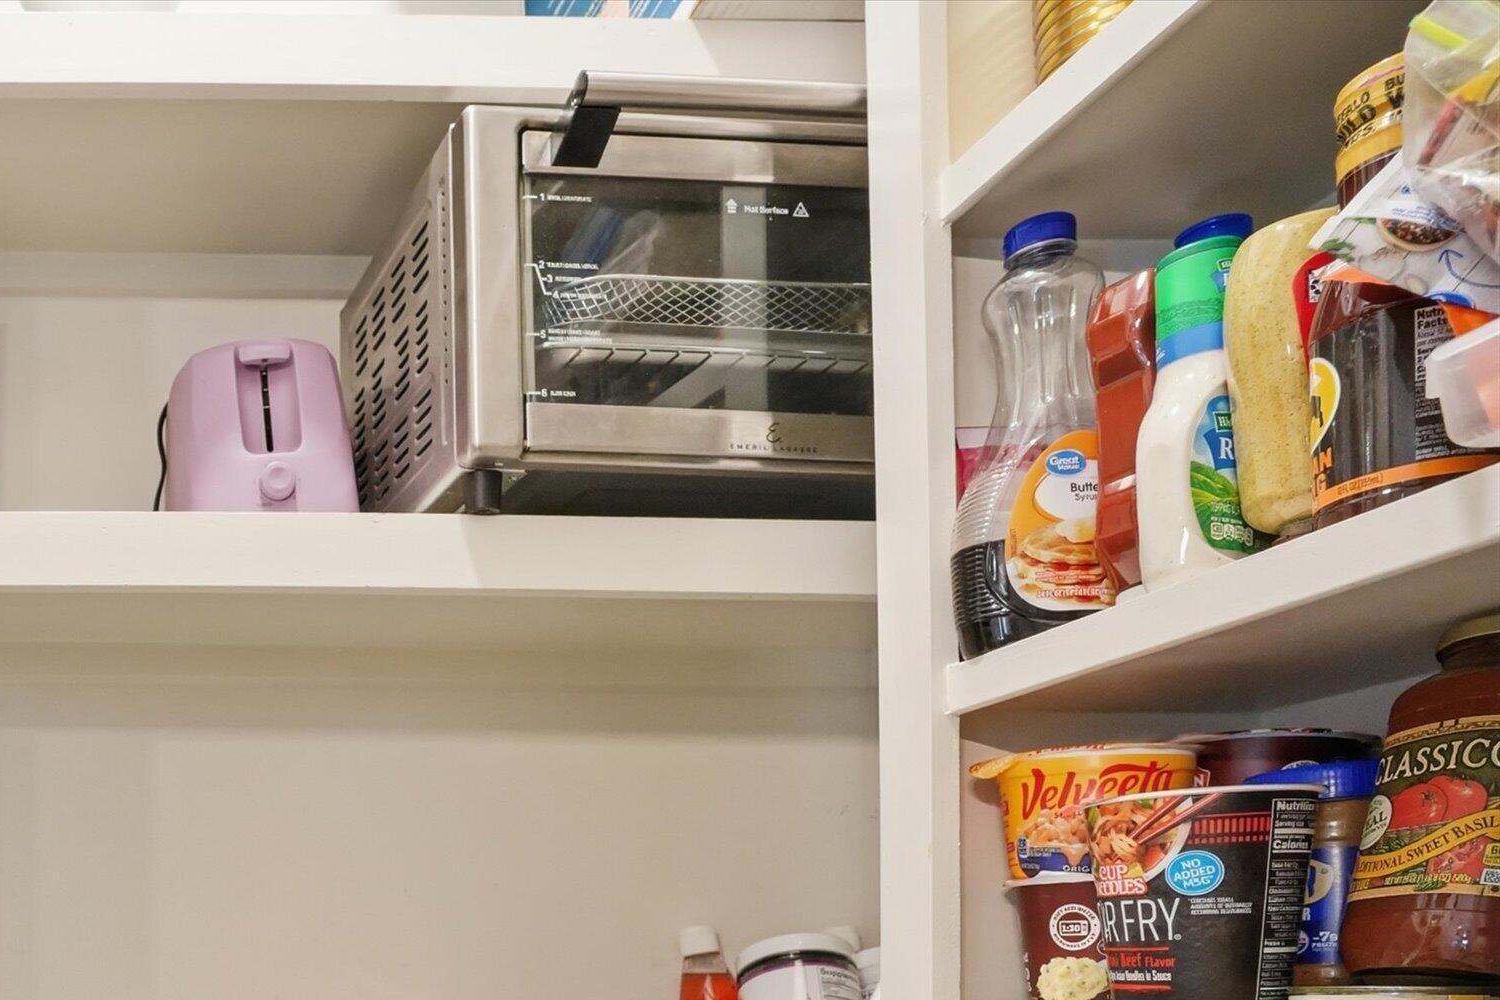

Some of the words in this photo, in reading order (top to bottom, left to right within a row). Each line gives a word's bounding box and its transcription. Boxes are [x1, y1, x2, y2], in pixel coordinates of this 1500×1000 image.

[1070, 482, 1098, 493] Butte
[1074, 493, 1098, 502] Syru
[1021, 762, 1173, 821] Velveeta
[1406, 833, 1450, 862] SWEET
[1452, 815, 1499, 839] BASIL
[1181, 859, 1201, 869] NO
[1100, 865, 1127, 880] CUP
[1174, 866, 1216, 881] ADDED
[1144, 957, 1176, 968] Flavor
[1152, 970, 1171, 980] Sauce
